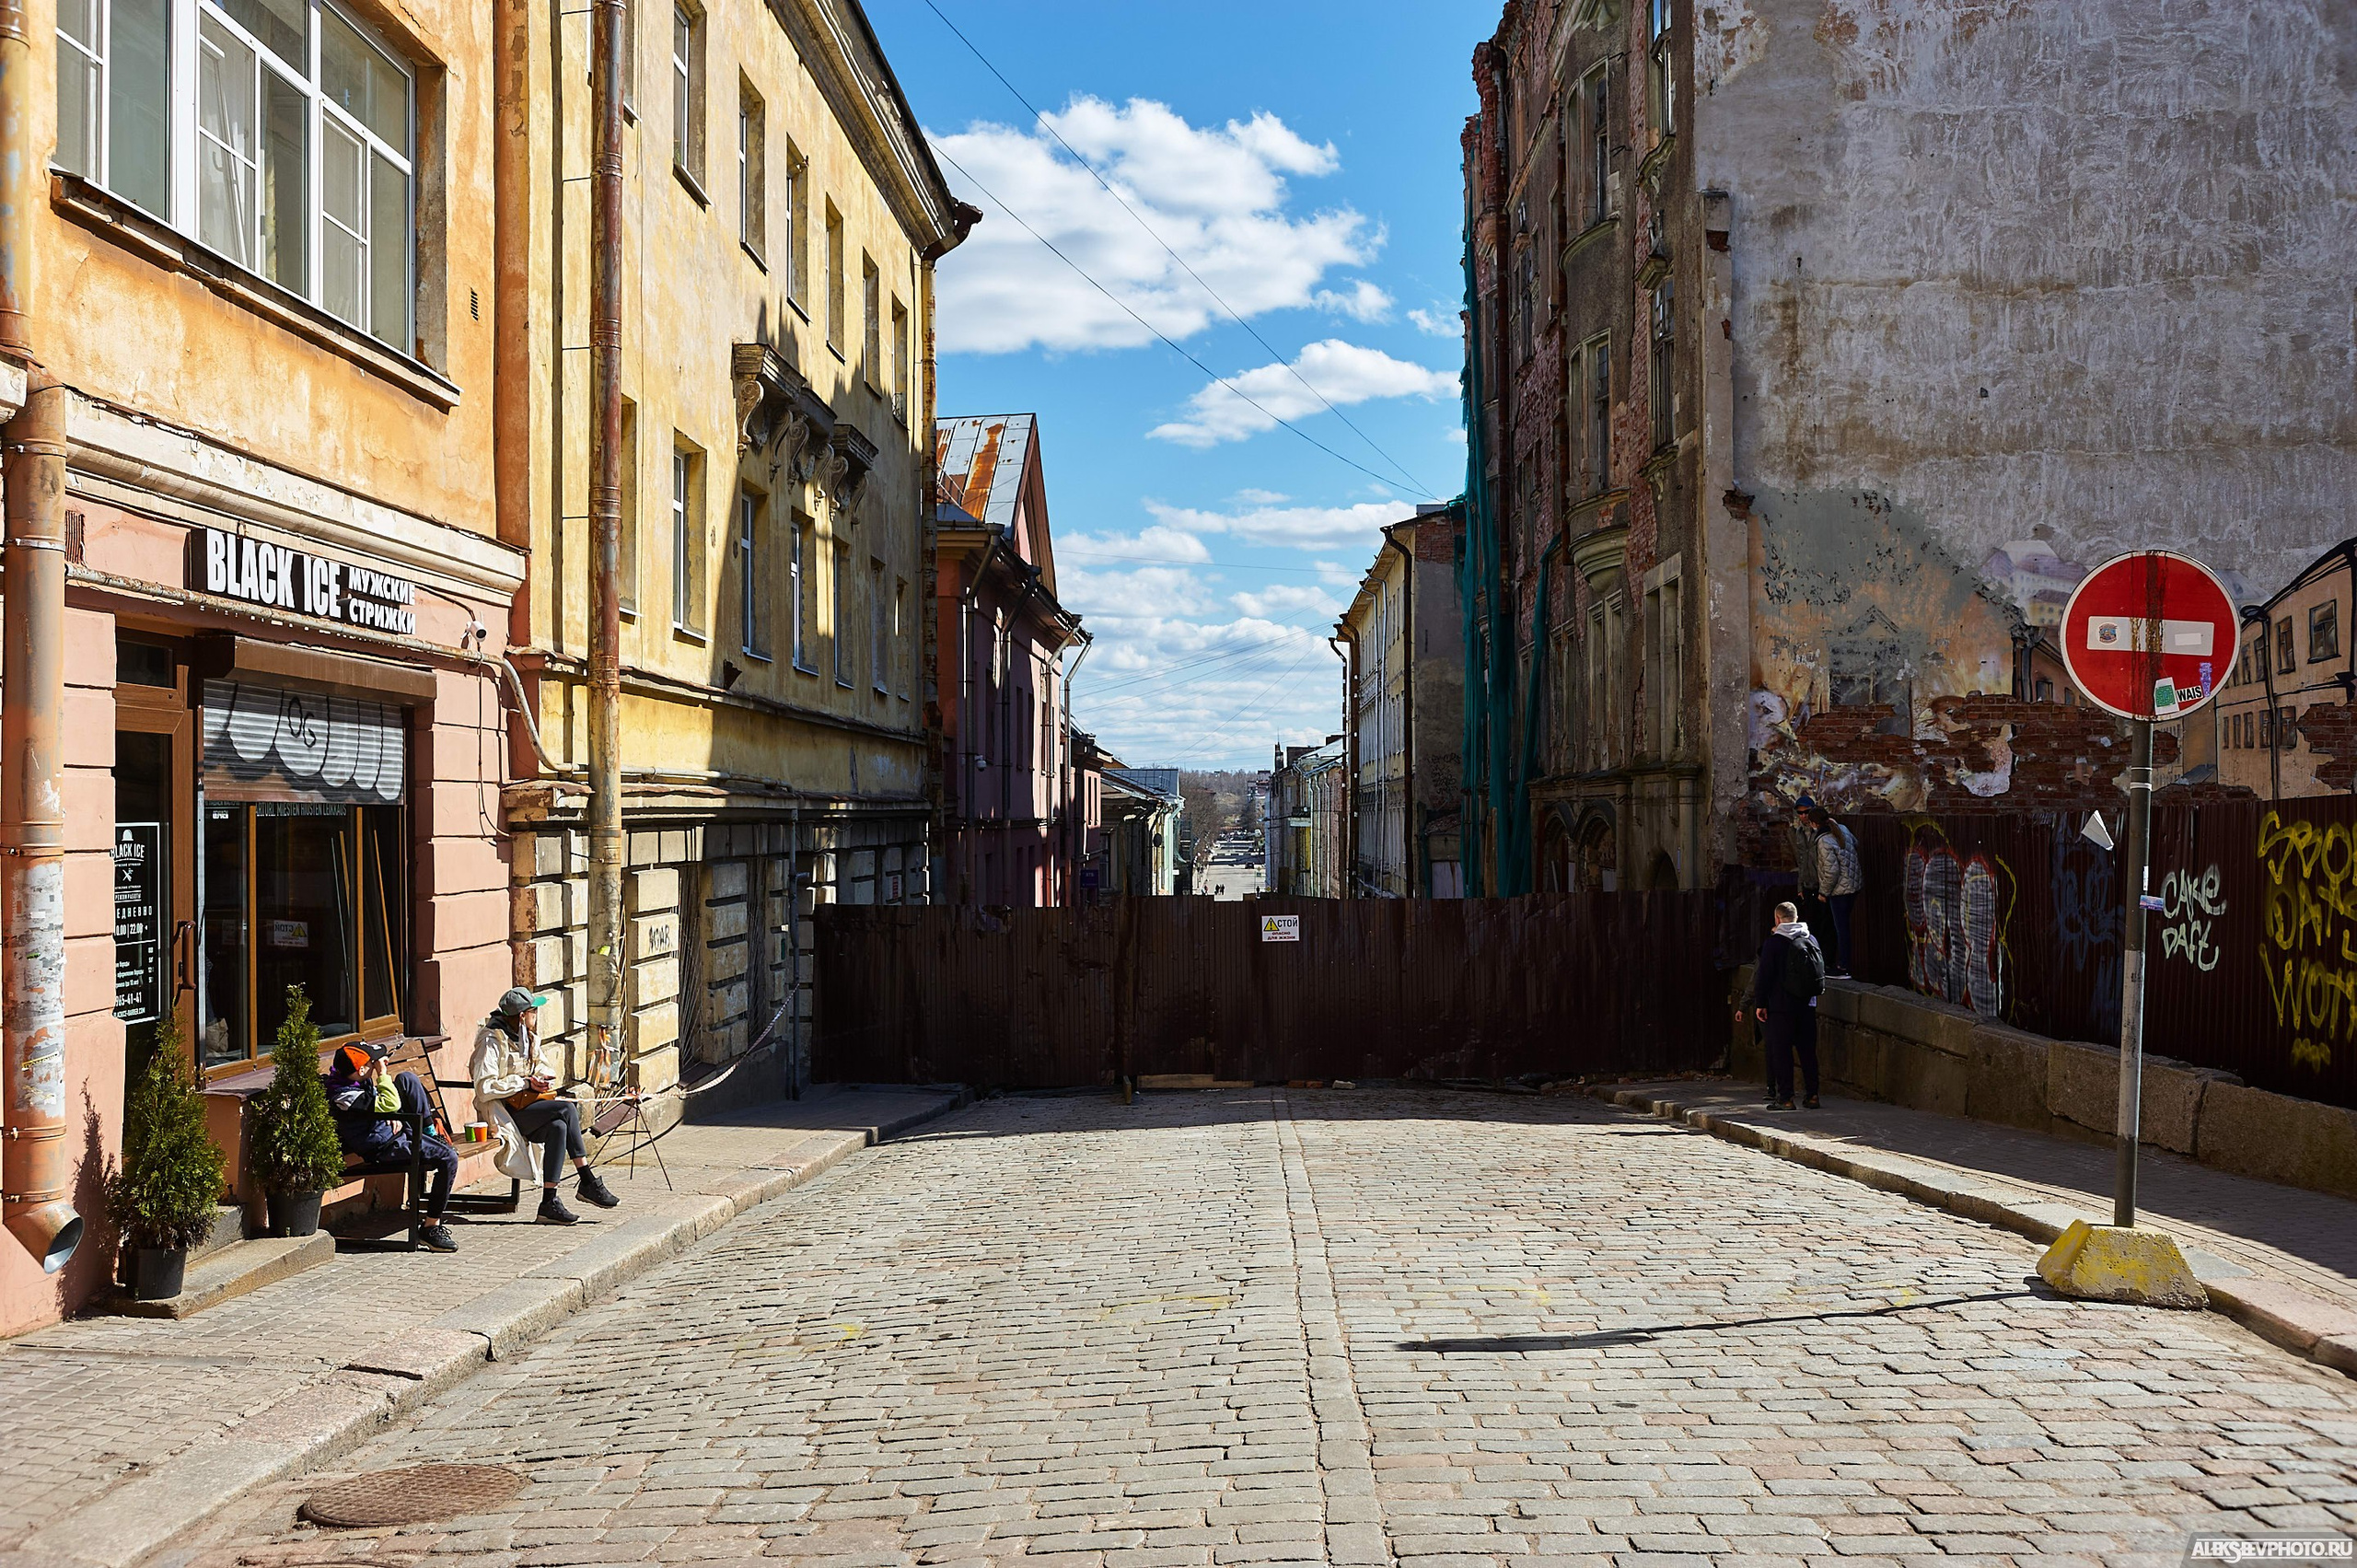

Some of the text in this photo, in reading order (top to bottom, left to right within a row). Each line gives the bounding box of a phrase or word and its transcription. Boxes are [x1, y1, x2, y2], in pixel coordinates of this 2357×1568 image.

[206, 528, 342, 619] BLACK ICE
[348, 565, 415, 606] МУЖСКИЕ
[349, 597, 415, 635] СТРИЖКИ
[2177, 686, 2202, 702] WAIS
[134, 843, 145, 858] ICE
[116, 905, 153, 920] ЕДНЕВНО
[114, 923, 127, 936] 0.00
[1277, 917, 1297, 927] СТОЙ
